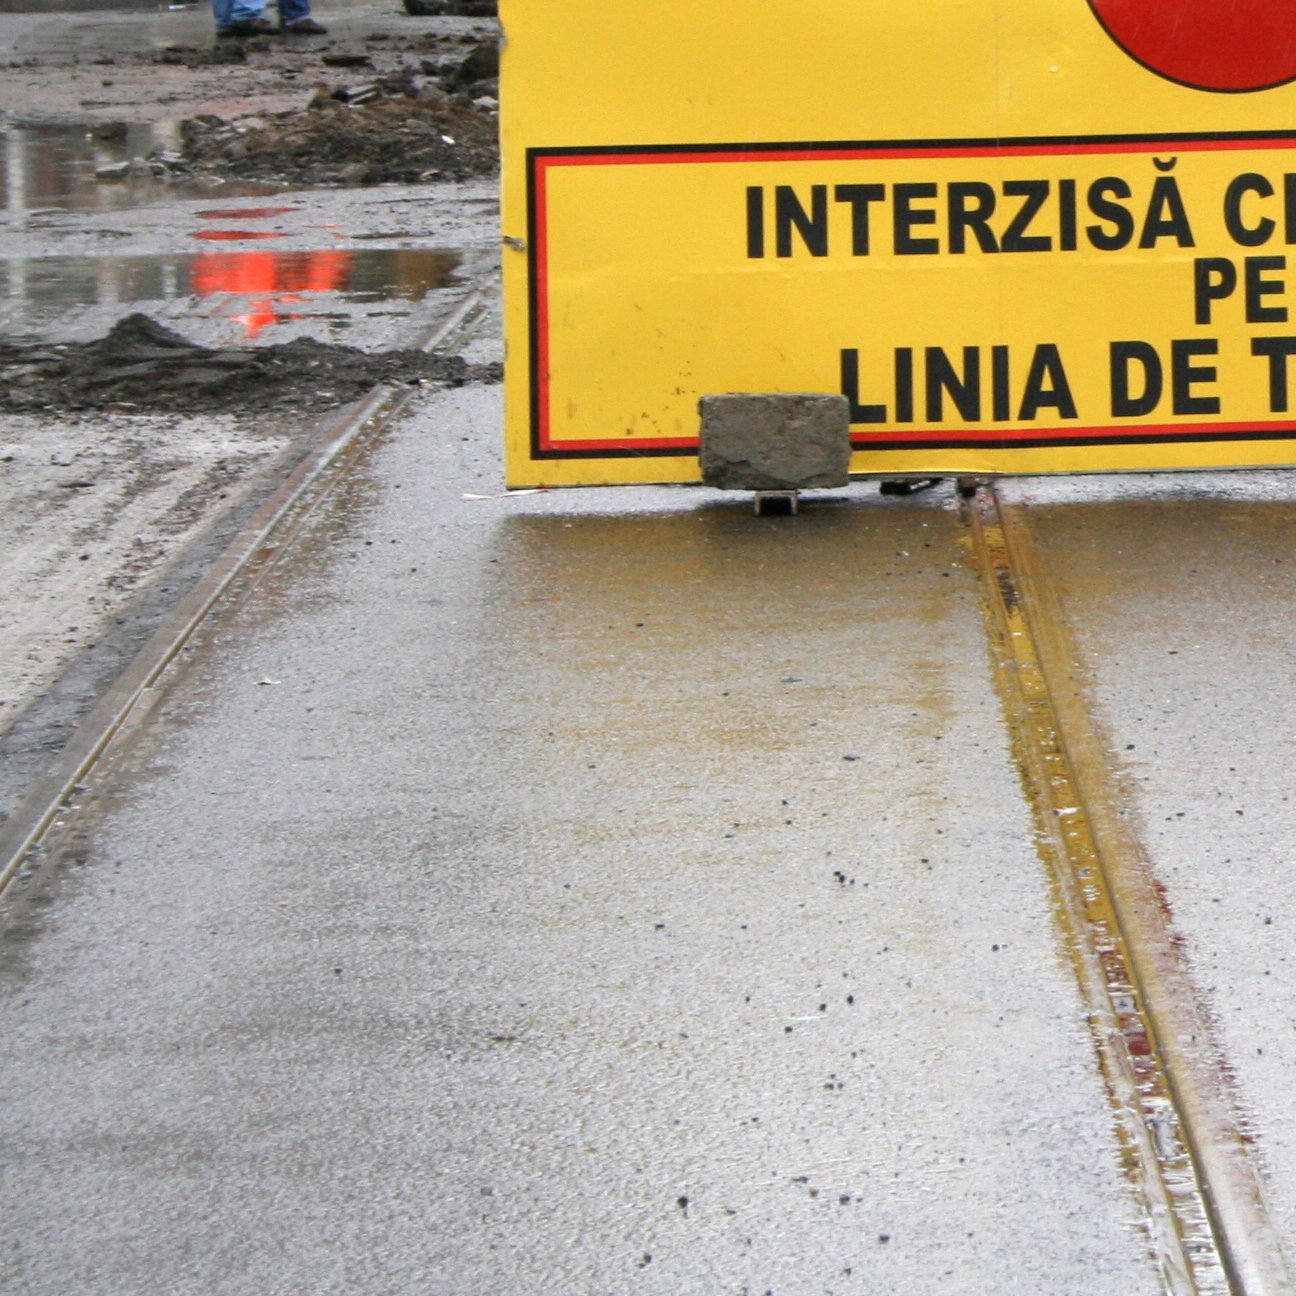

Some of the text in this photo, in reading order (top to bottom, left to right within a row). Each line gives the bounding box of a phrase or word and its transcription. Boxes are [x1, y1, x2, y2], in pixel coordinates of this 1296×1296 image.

[747, 157, 1194, 258] INTERZISĂ
[1194, 256, 1288, 325] PE
[840, 344, 1077, 423] LINIA
[1110, 338, 1220, 417] DE
